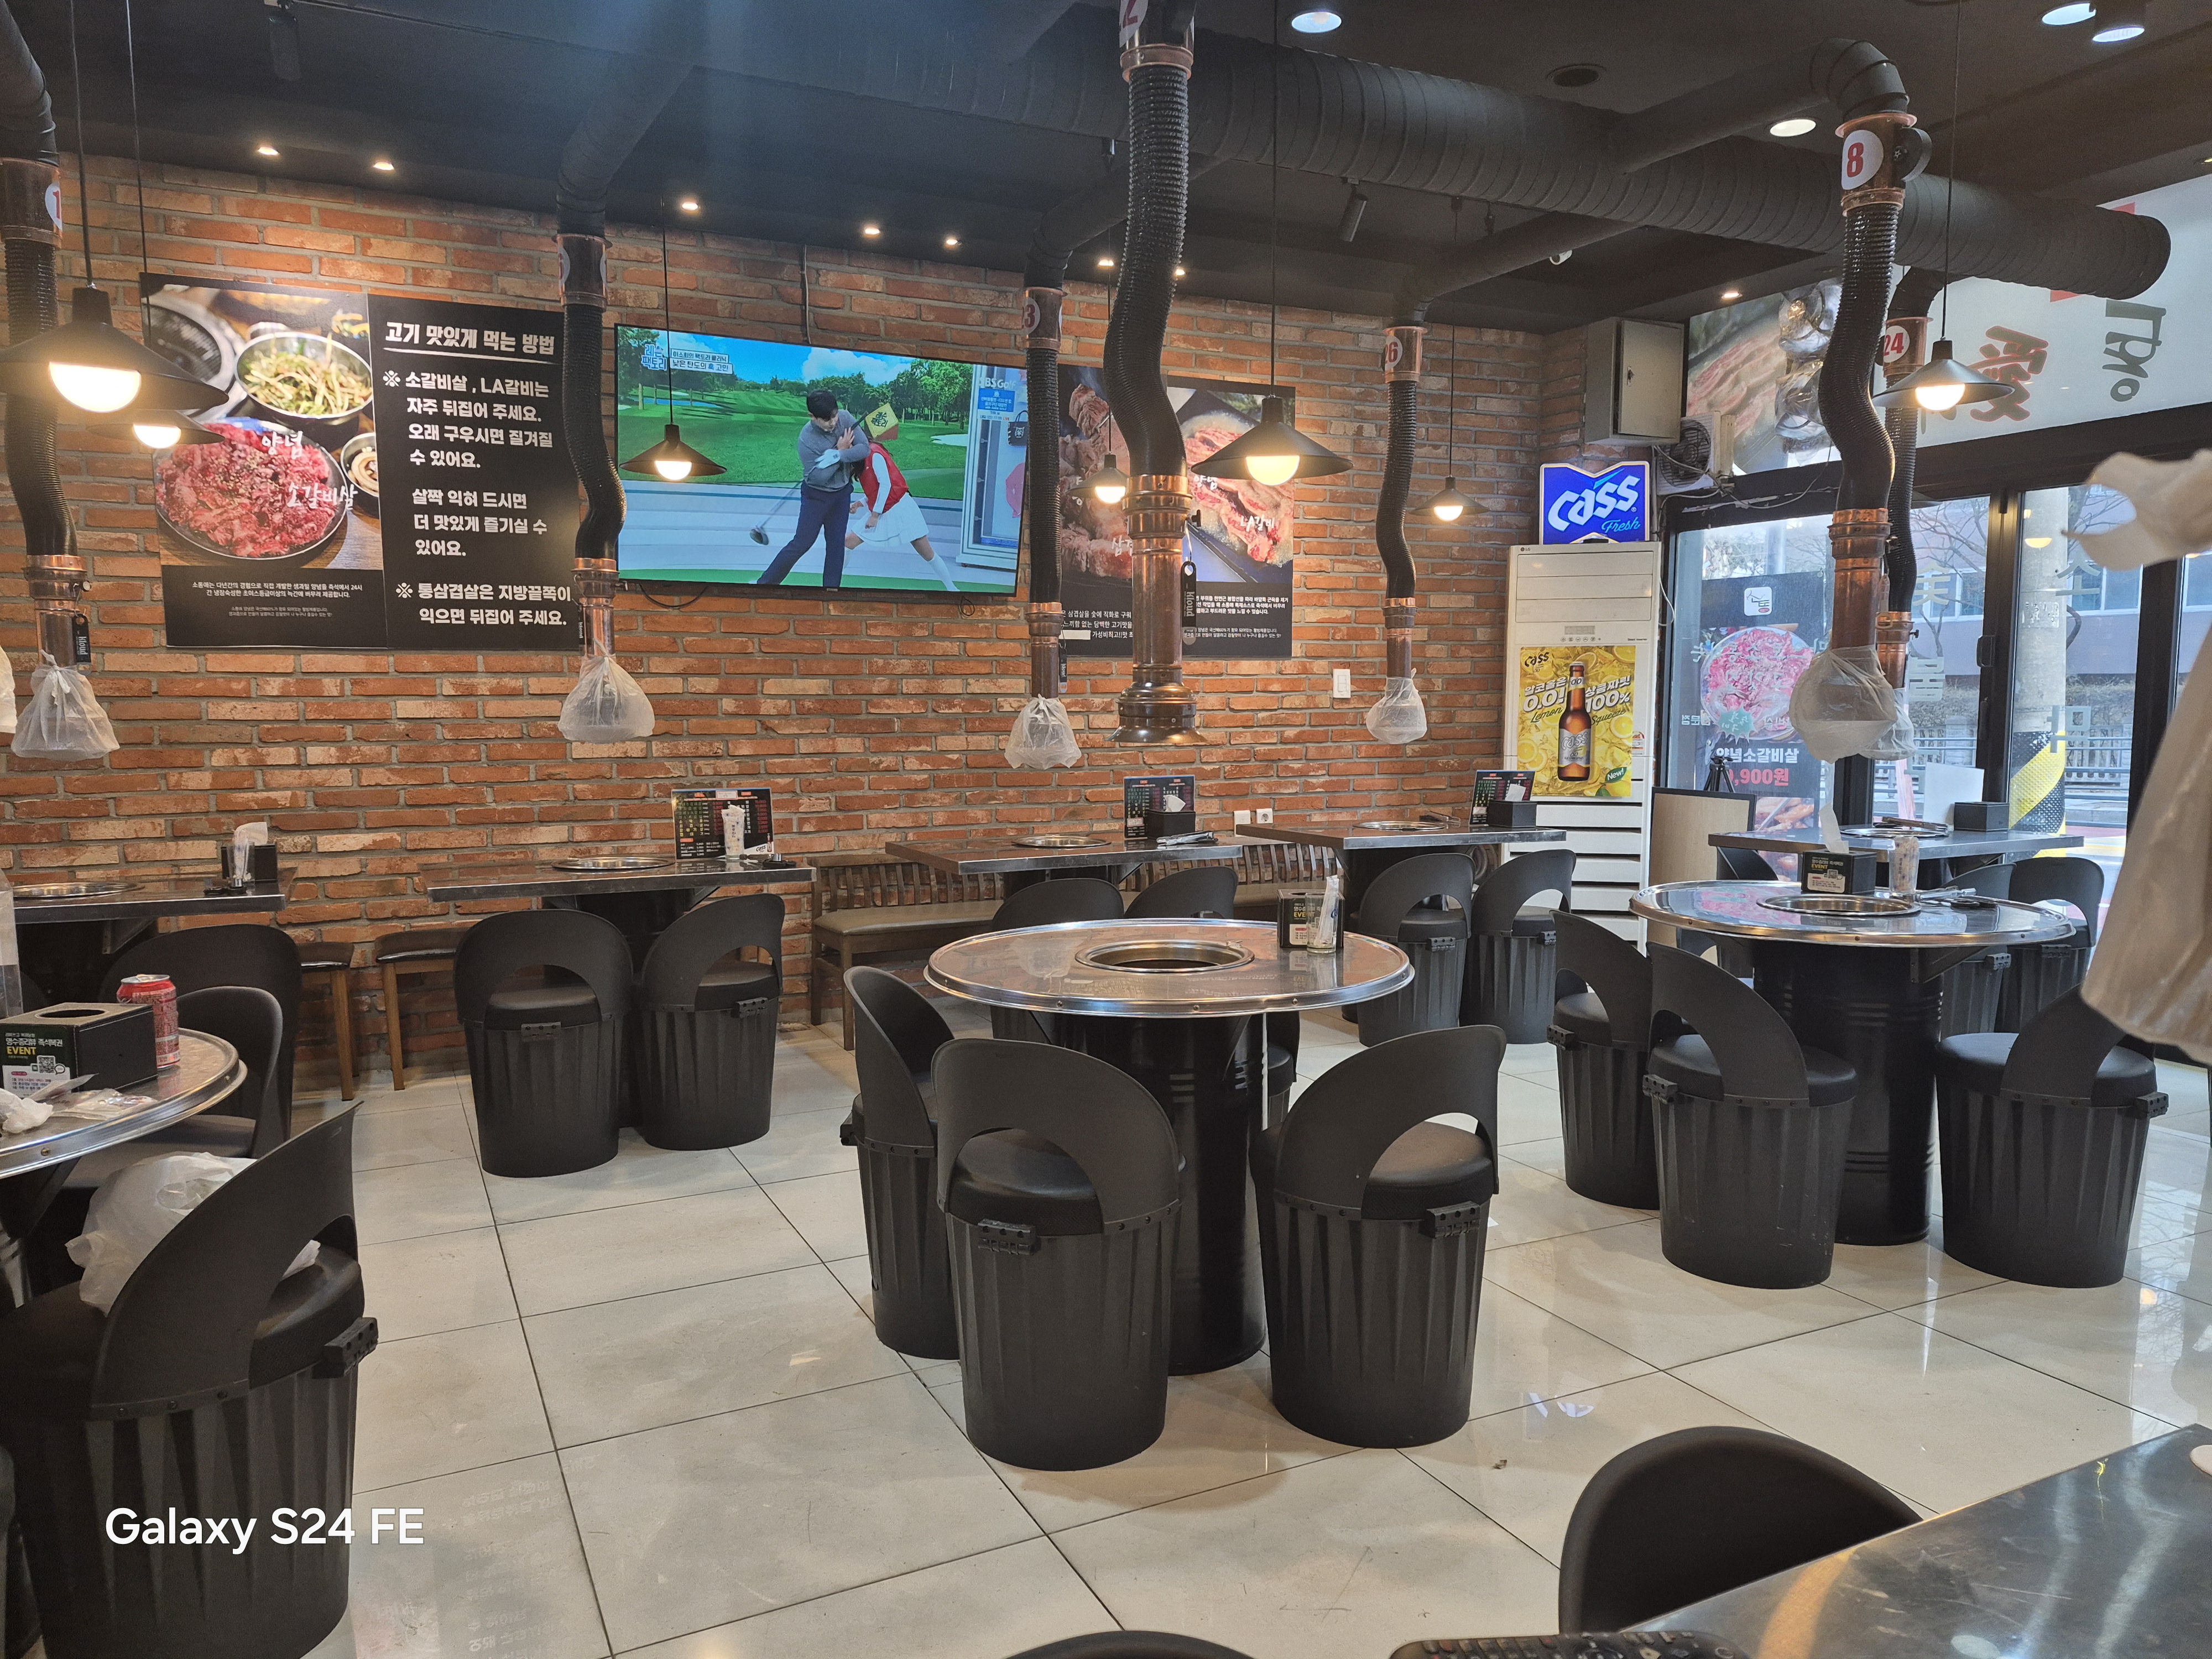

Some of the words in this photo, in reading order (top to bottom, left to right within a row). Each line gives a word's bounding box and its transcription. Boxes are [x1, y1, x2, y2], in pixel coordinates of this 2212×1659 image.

[1846, 142, 1864, 178] 8
[1022, 304, 1035, 328] 3
[385, 322, 420, 343] 고기
[426, 325, 477, 349] 맛있게
[483, 330, 516, 352] 먹는
[523, 334, 555, 355] 방법
[1884, 332, 1903, 356] 24
[641, 356, 667, 371] 팩토리
[687, 361, 707, 369] 탄도의
[481, 378, 549, 398] LA갈비는
[997, 379, 1016, 389] Golf
[407, 398, 438, 415] 자주
[443, 400, 488, 418] 뒤집어
[493, 403, 542, 421] 주세요.
[262, 431, 304, 459] 양념
[409, 423, 440, 441] 오래
[444, 425, 505, 445] 구우시면
[509, 429, 554, 448] 질겨질
[410, 448, 426, 466] 수
[430, 450, 481, 468] 있어요.
[287, 482, 358, 510] 소갈비살
[412, 489, 444, 505] 살짝
[447, 491, 478, 507] 익혀
[483, 492, 527, 509] 드시면
[414, 514, 429, 531] 더
[434, 515, 479, 533] 맛있게
[484, 517, 529, 534] 즐기실
[533, 519, 547, 535] 수
[1240, 514, 1275, 532] LA갈비
[1601, 517, 1641, 533] Fresh
[415, 539, 466, 556] 있어요.
[418, 583, 494, 601] 통삼겹살은
[498, 585, 572, 602] 지방끝쪽이
[1186, 591, 1195, 617] Kloud
[419, 608, 465, 625] 익으면
[470, 609, 514, 625] 뒤집어
[519, 610, 567, 626] 주세요.
[78, 636, 88, 655] Kloud
[1525, 676, 1567, 697] 알코올은
[1585, 675, 1631, 697] 상큼짜릿
[1523, 687, 1566, 712] 0.0!
[1585, 690, 1631, 713] 100%
[1531, 706, 1564, 723] Lemon
[1591, 708, 1627, 726] Squeeze
[1716, 748, 1799, 764] 양념소갈비살
[1607, 768, 1624, 781] New!
[7, 1046, 36, 1055] EVENT
